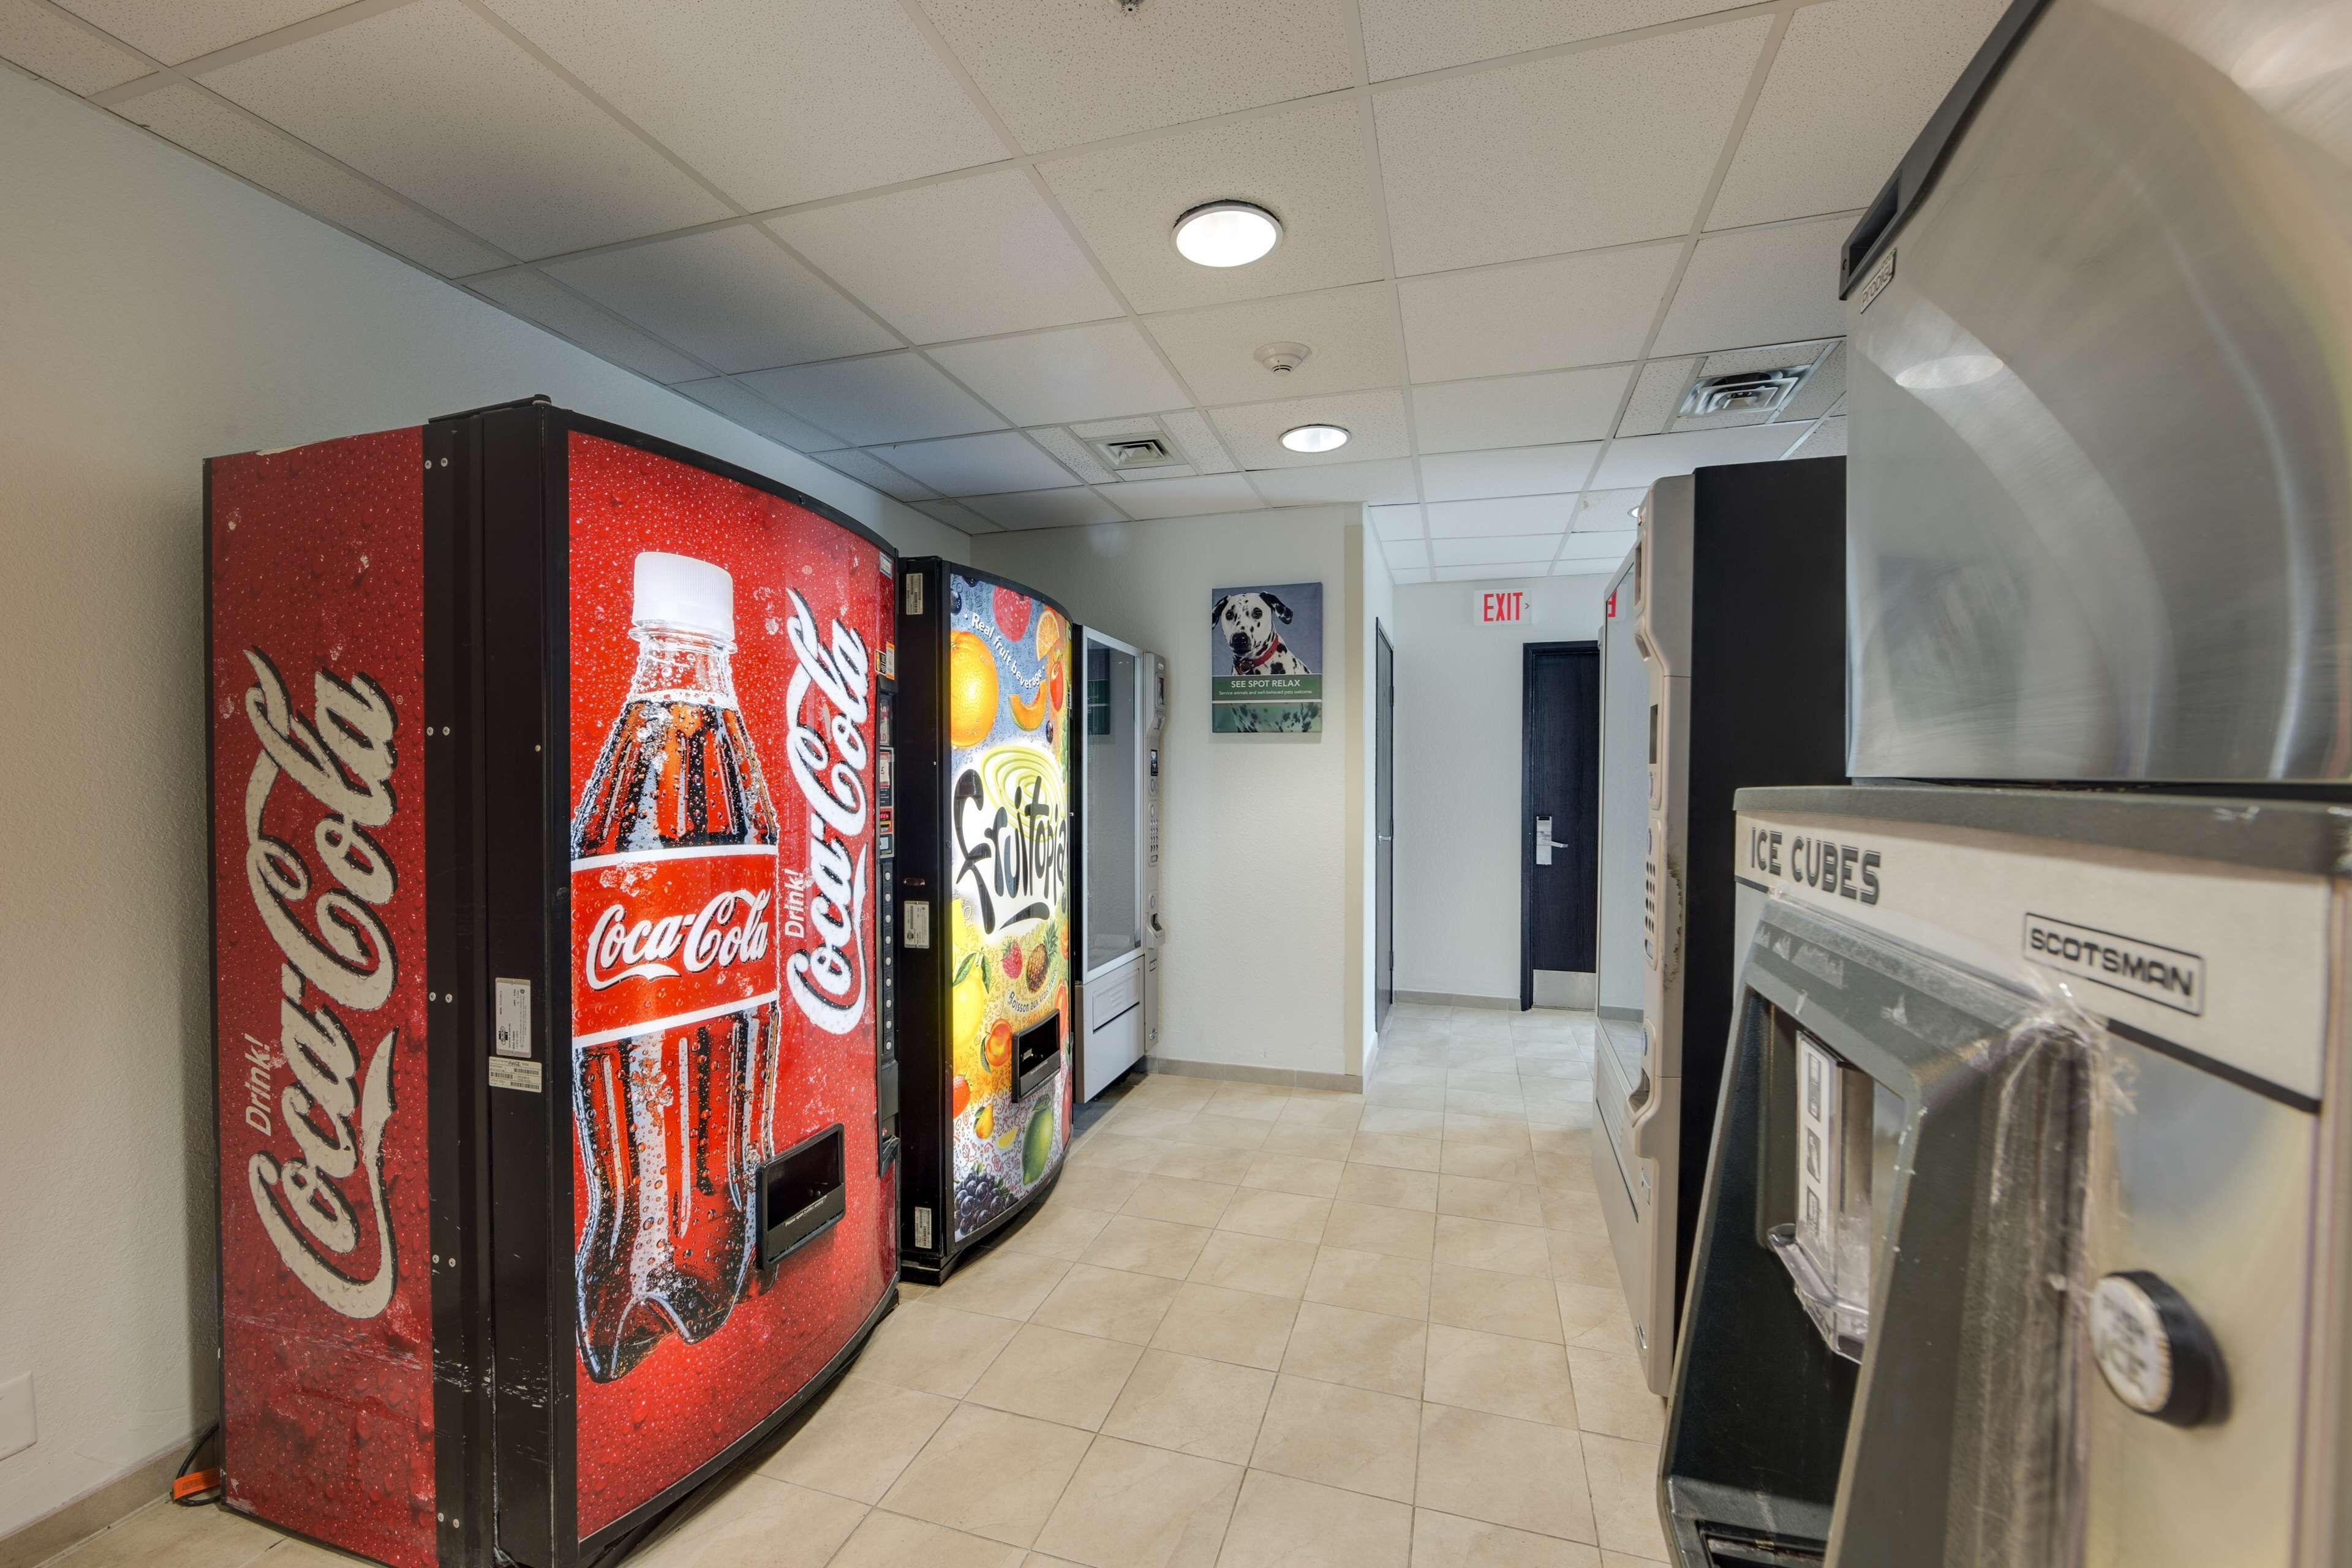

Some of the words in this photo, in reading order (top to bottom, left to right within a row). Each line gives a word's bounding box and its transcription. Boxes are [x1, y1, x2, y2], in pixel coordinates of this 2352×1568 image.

[970, 611, 996, 639] Real
[993, 635, 1014, 666] fruit
[1011, 660, 1043, 690] beverage
[1483, 592, 1523, 622] EXIT
[785, 587, 869, 1035] Coca-Cola
[953, 768, 1067, 935] Fruitopia
[784, 869, 804, 938] Drink!
[1751, 827, 1783, 876] ICE
[1791, 835, 1882, 906] CUBES
[243, 644, 398, 1320] Coca-Cola
[586, 888, 772, 992] Coca-Cola
[2030, 927, 2193, 997] SCOTSMAN
[244, 1033, 271, 1137] Drink!
